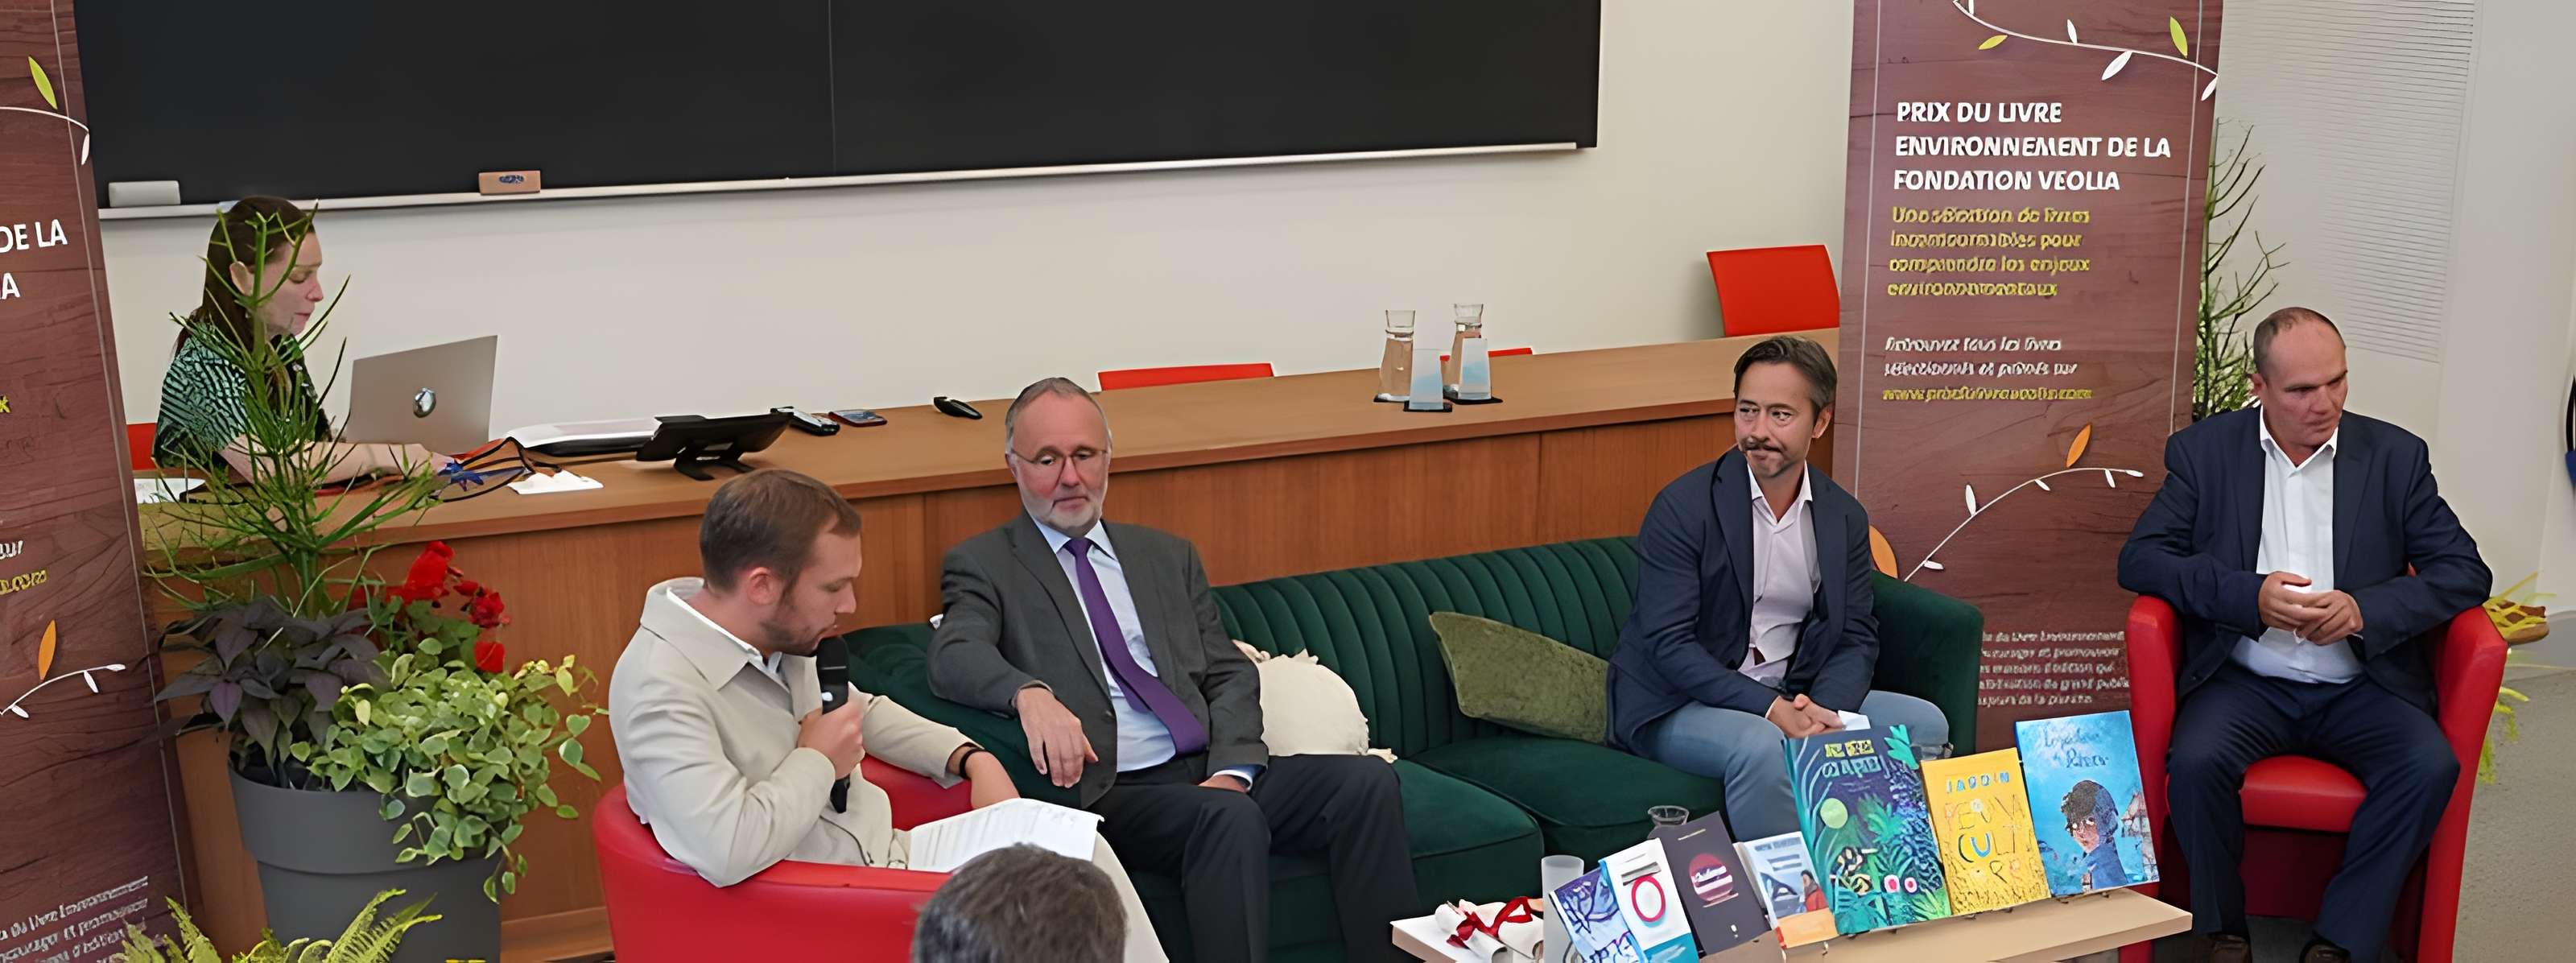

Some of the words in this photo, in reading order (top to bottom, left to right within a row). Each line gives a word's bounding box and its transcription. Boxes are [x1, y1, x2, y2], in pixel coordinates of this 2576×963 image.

[1897, 101, 1951, 122] PRIX
[1957, 102, 1991, 122] DU
[1998, 102, 2062, 123] LIVRE
[1895, 135, 2102, 157] ENVIRONNEMENT
[2107, 137, 2138, 157] DE
[2144, 137, 2171, 158] LA
[1893, 170, 2032, 191] FONDATION
[2038, 171, 2120, 191] VEOLIA
[35, 218, 68, 248] LA
